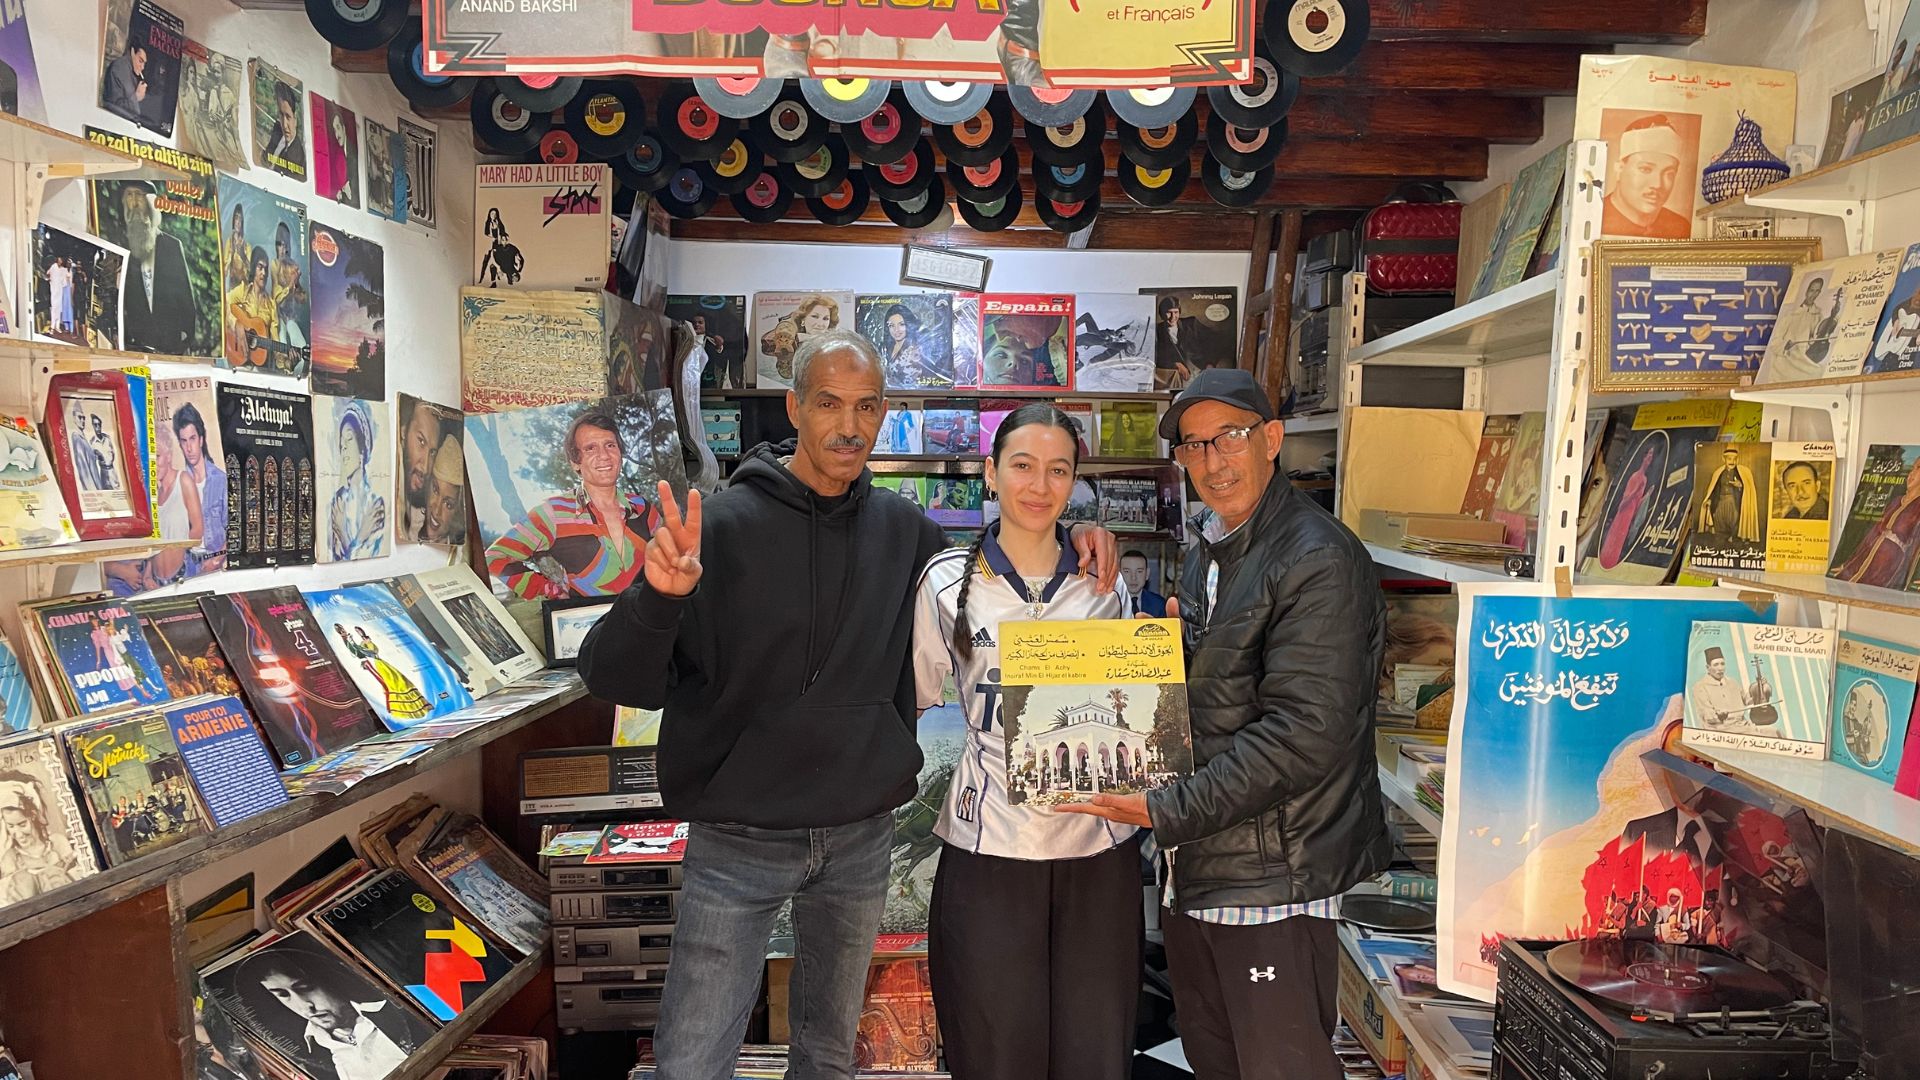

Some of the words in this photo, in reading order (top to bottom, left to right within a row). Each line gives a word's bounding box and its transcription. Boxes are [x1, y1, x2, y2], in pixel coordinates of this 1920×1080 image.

[460, 0, 514, 13] ANAND
[520, 0, 577, 13] BAKSHI
[1107, 9, 1120, 20] et
[1124, 6, 1195, 23] Français
[150, 25, 181, 48] ENRICO
[149, 36, 181, 60] MACIAS
[1868, 104, 1894, 131] LES
[89, 131, 105, 146] zo
[107, 136, 128, 153] zal
[130, 138, 154, 161] het
[154, 147, 190, 173] altijd
[189, 156, 213, 176] zijn
[480, 166, 507, 183] MARY
[511, 166, 533, 183] HAD
[535, 166, 543, 182] A
[546, 166, 580, 182] LITTLE
[582, 166, 604, 182] BOY
[154, 198, 216, 222] abraham
[984, 301, 1071, 314] España!
[156, 379, 209, 391] REMORDS
[240, 396, 293, 431] ¡Aleluya!
[1691, 556, 1734, 568] BOUBAGRA
[294, 630, 318, 656] 4
[972, 638, 996, 648] didas
[1754, 644, 1775, 652] SAHIB
[1794, 646, 1803, 654] EL
[1805, 647, 1826, 655] MAATI
[184, 711, 212, 724] POUR
[212, 706, 227, 718] TOI
[177, 713, 248, 745] ARMENIE
[323, 870, 410, 926] FOREIGNER
